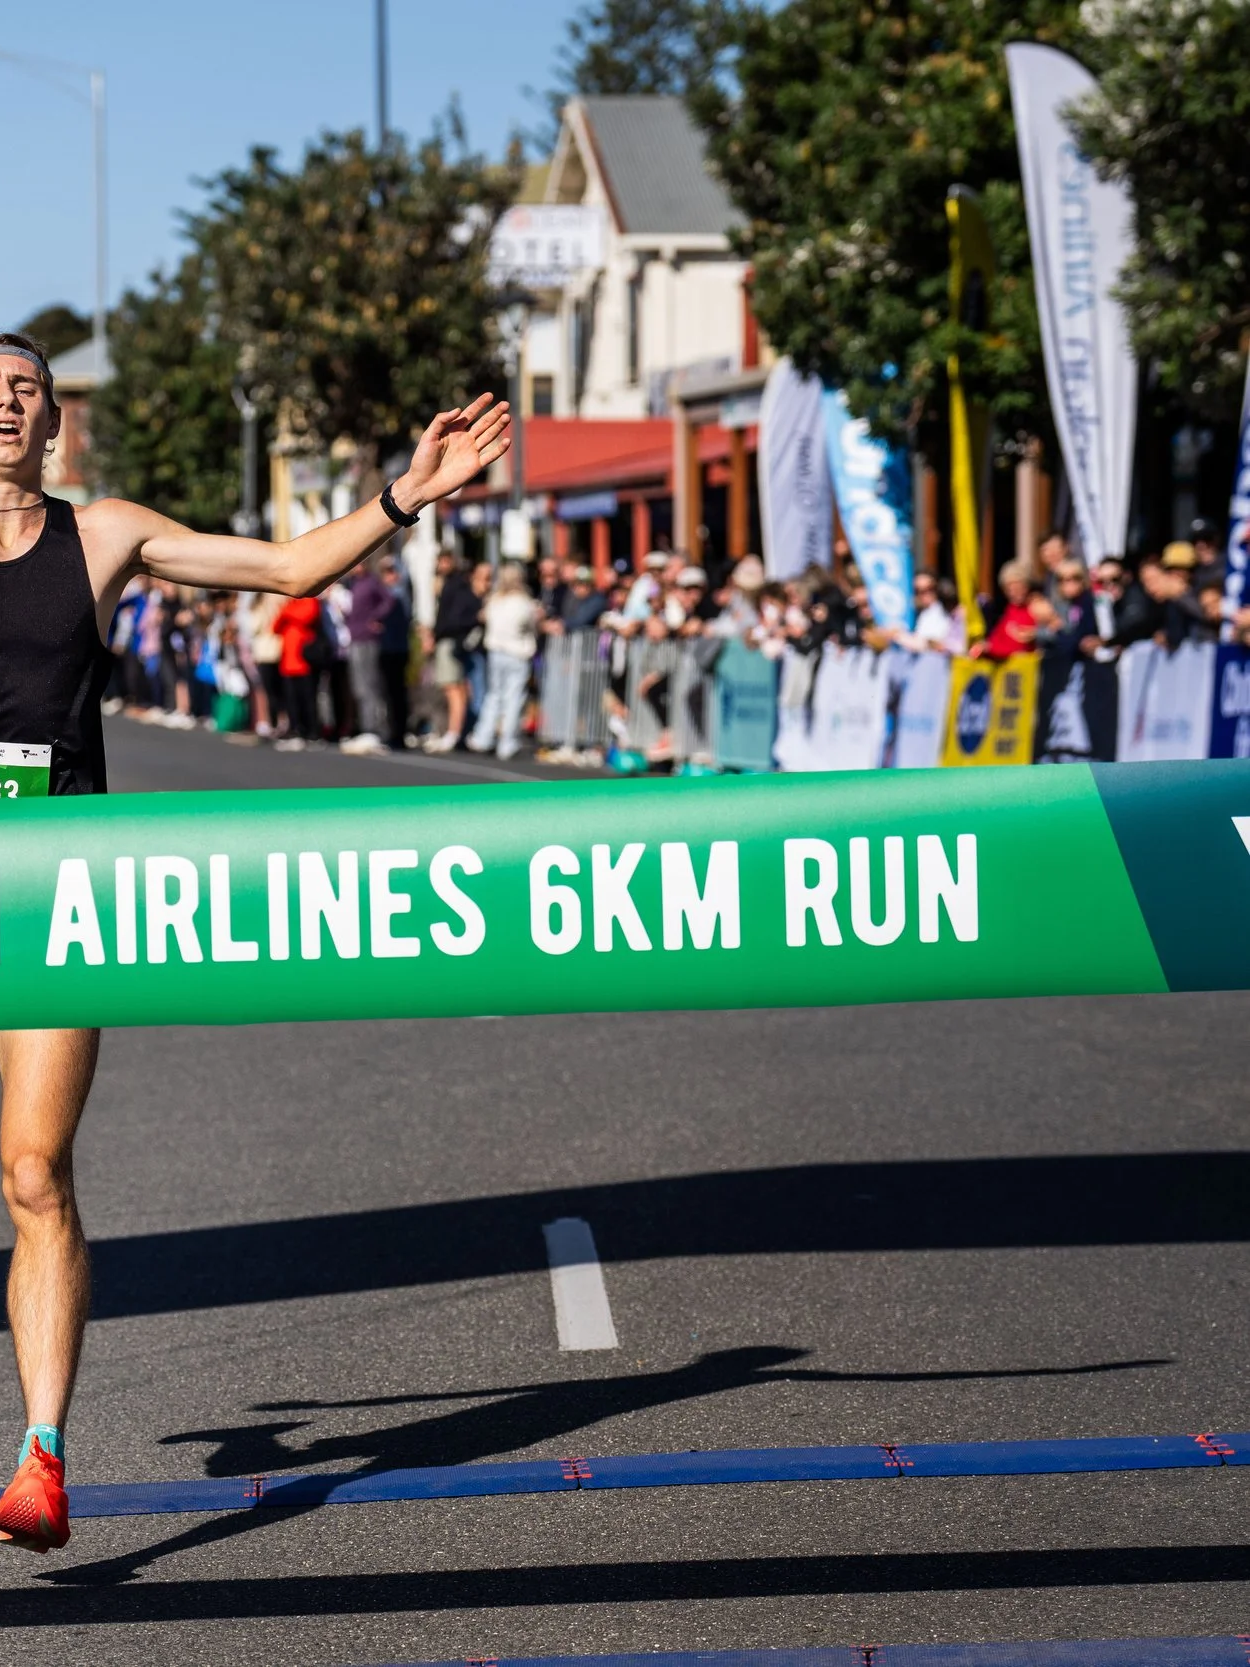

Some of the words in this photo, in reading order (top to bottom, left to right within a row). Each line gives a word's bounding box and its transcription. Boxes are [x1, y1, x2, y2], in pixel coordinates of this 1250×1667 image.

[491, 238, 586, 266] OTEL
[45, 844, 485, 966] AIRLINES
[529, 841, 740, 955] 6KM
[784, 834, 978, 947] RUN
